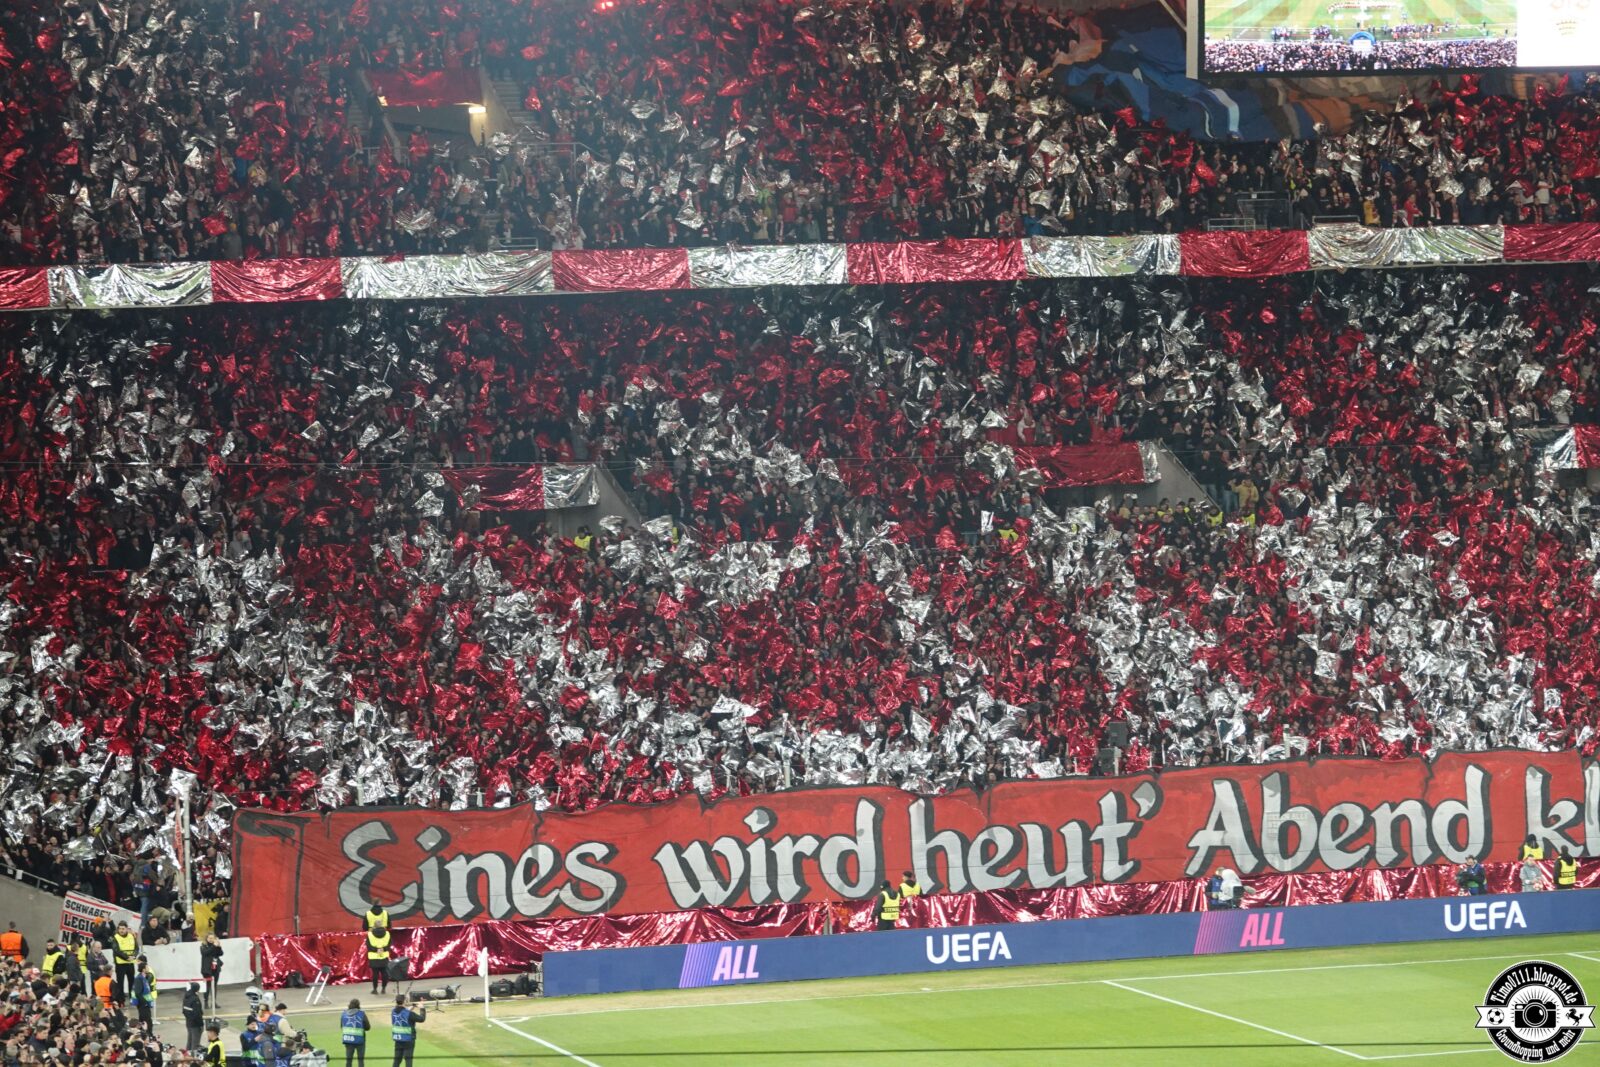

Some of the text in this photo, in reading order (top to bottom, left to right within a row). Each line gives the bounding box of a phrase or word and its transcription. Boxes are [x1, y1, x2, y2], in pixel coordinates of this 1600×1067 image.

[338, 819, 620, 919] Eines
[653, 798, 880, 909] wird
[908, 780, 1159, 896] heut'
[1185, 763, 1488, 877] Abend
[1239, 911, 1285, 948] ALL
[1444, 900, 1527, 932] UEFA
[712, 944, 760, 981] ALL
[925, 931, 1012, 964] UEFA
